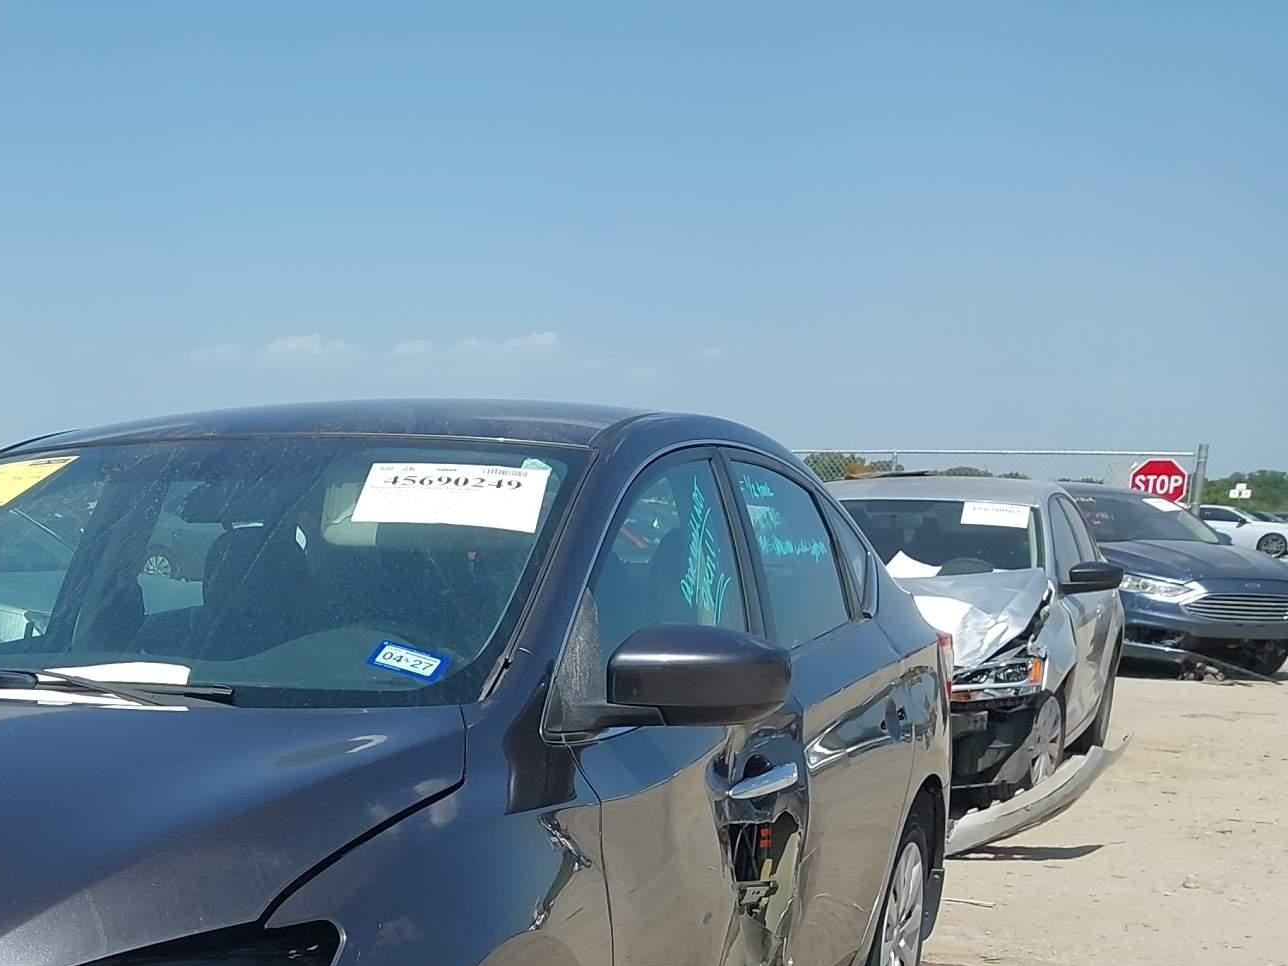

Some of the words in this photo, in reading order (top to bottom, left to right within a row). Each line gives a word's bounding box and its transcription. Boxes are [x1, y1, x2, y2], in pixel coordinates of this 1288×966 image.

[383, 474, 523, 491] 45690249
[1135, 475, 1183, 494] STOP
[381, 651, 404, 664] 04
[410, 659, 434, 671] 27
